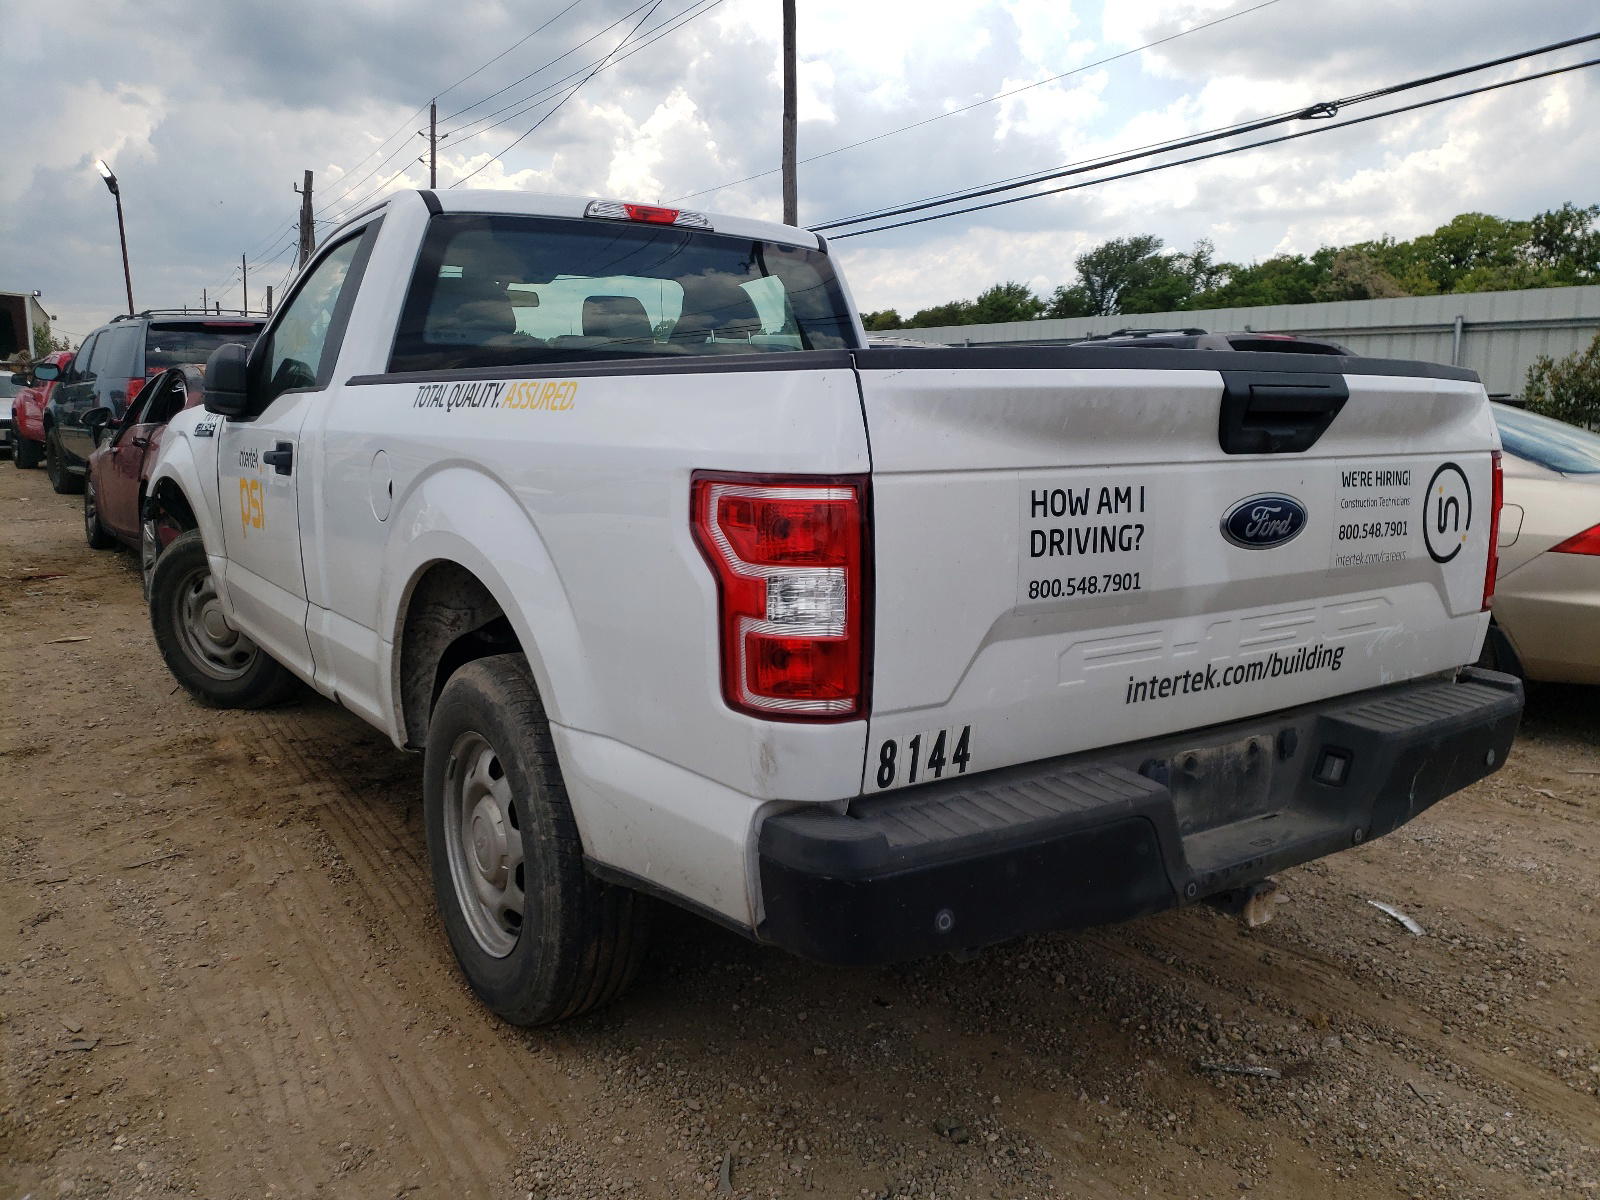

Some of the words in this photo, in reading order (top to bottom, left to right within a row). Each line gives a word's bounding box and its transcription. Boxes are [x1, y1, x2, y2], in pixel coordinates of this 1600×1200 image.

[413, 384, 449, 408] TOTAL
[447, 382, 506, 412] QUALITY.
[501, 381, 578, 411] ASSURED.
[1341, 471, 1373, 488] WE'RE
[1375, 470, 1411, 487] HIRING!
[240, 463, 264, 538] psi
[1031, 487, 1091, 518] HOW
[1096, 486, 1132, 515] AM
[1139, 485, 1145, 513] I
[1340, 497, 1378, 509] Construction
[1245, 506, 1293, 538] Ford
[1338, 520, 1408, 541] 800.548.7901
[1030, 523, 1145, 558] DRIVING?
[1028, 572, 1142, 600] 800.548.7901
[1126, 643, 1345, 705] intertek.com/building
[877, 725, 971, 789] 8144
